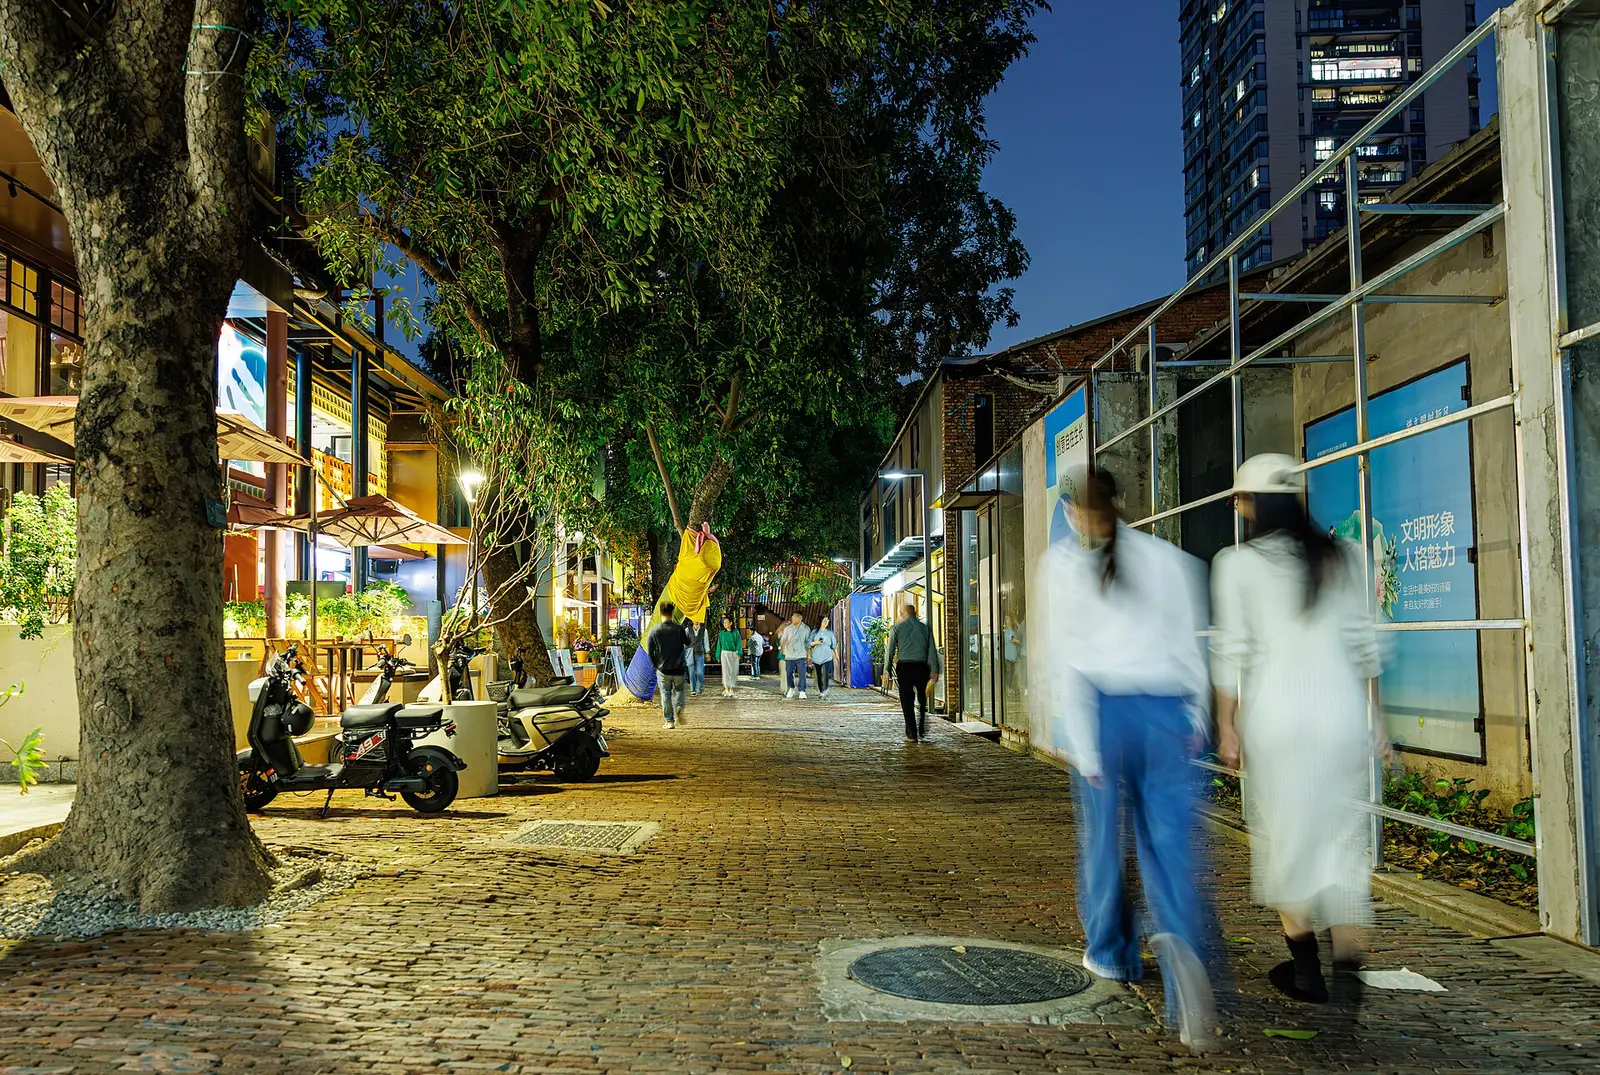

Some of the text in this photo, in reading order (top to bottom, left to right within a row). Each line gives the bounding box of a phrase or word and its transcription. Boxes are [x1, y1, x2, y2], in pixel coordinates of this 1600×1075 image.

[1400, 510, 1455, 544] 文明形象
[1402, 541, 1456, 573] 人格魅力
